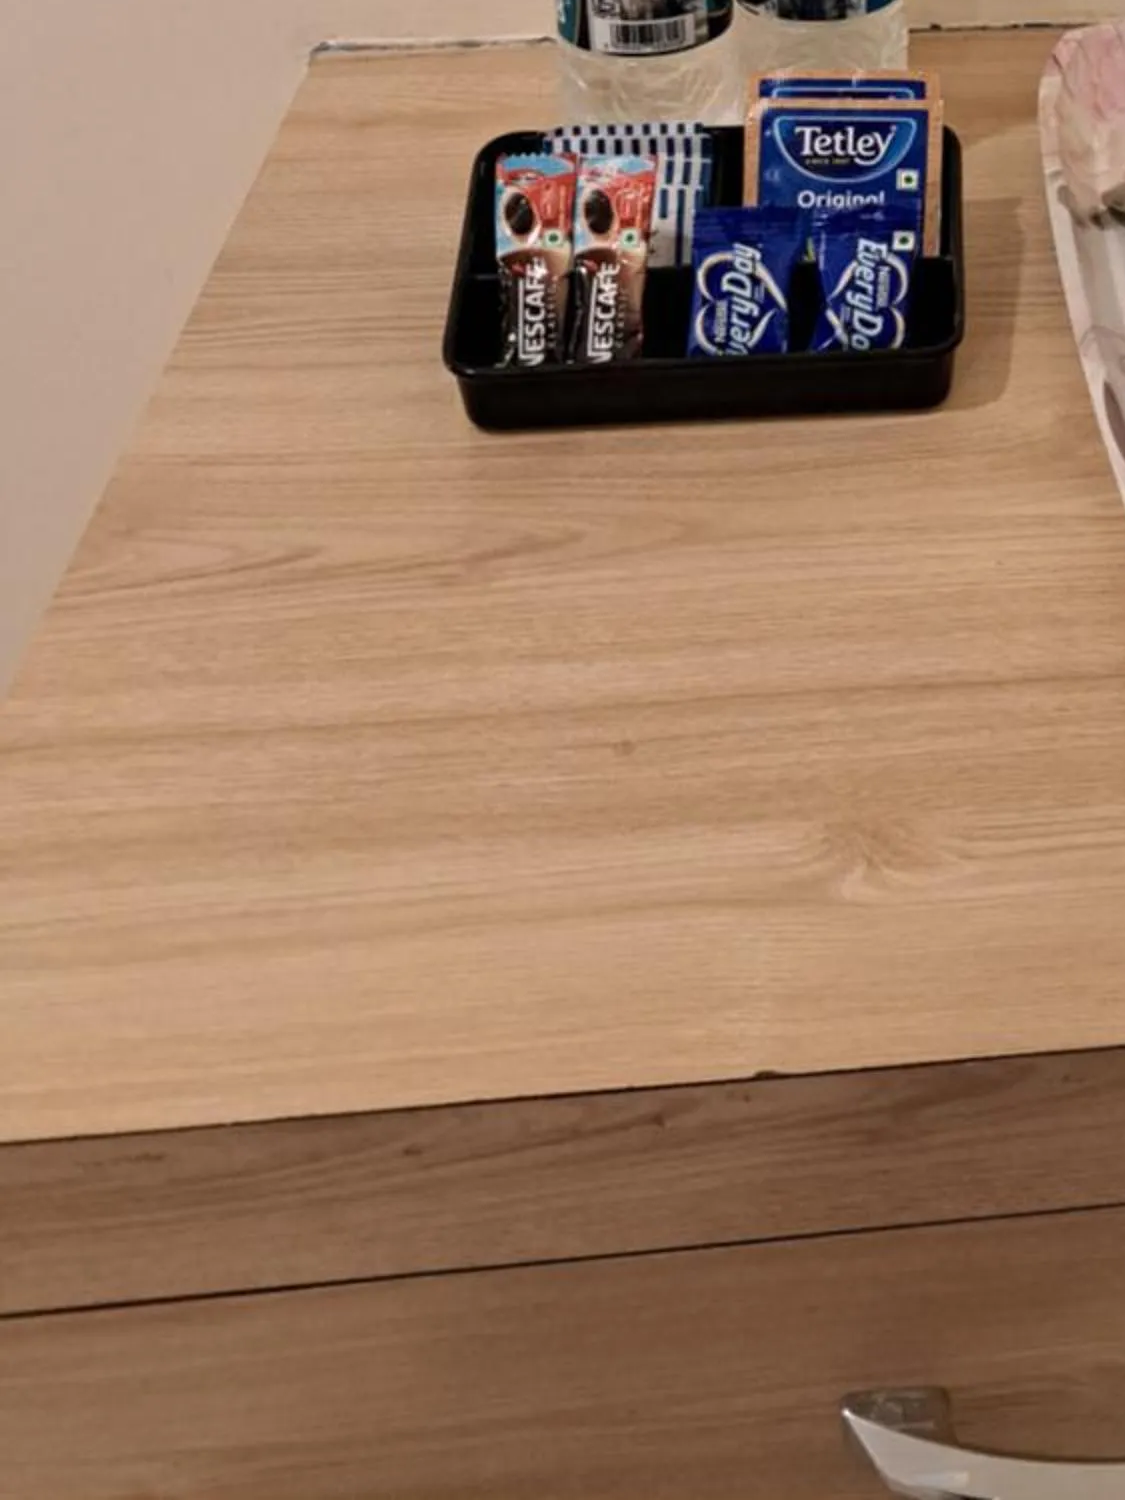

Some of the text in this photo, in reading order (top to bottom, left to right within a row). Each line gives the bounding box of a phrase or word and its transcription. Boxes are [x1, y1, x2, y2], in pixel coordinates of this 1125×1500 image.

[794, 124, 897, 166] Tetley
[797, 189, 886, 209] Original
[721, 242, 762, 356] veryDay
